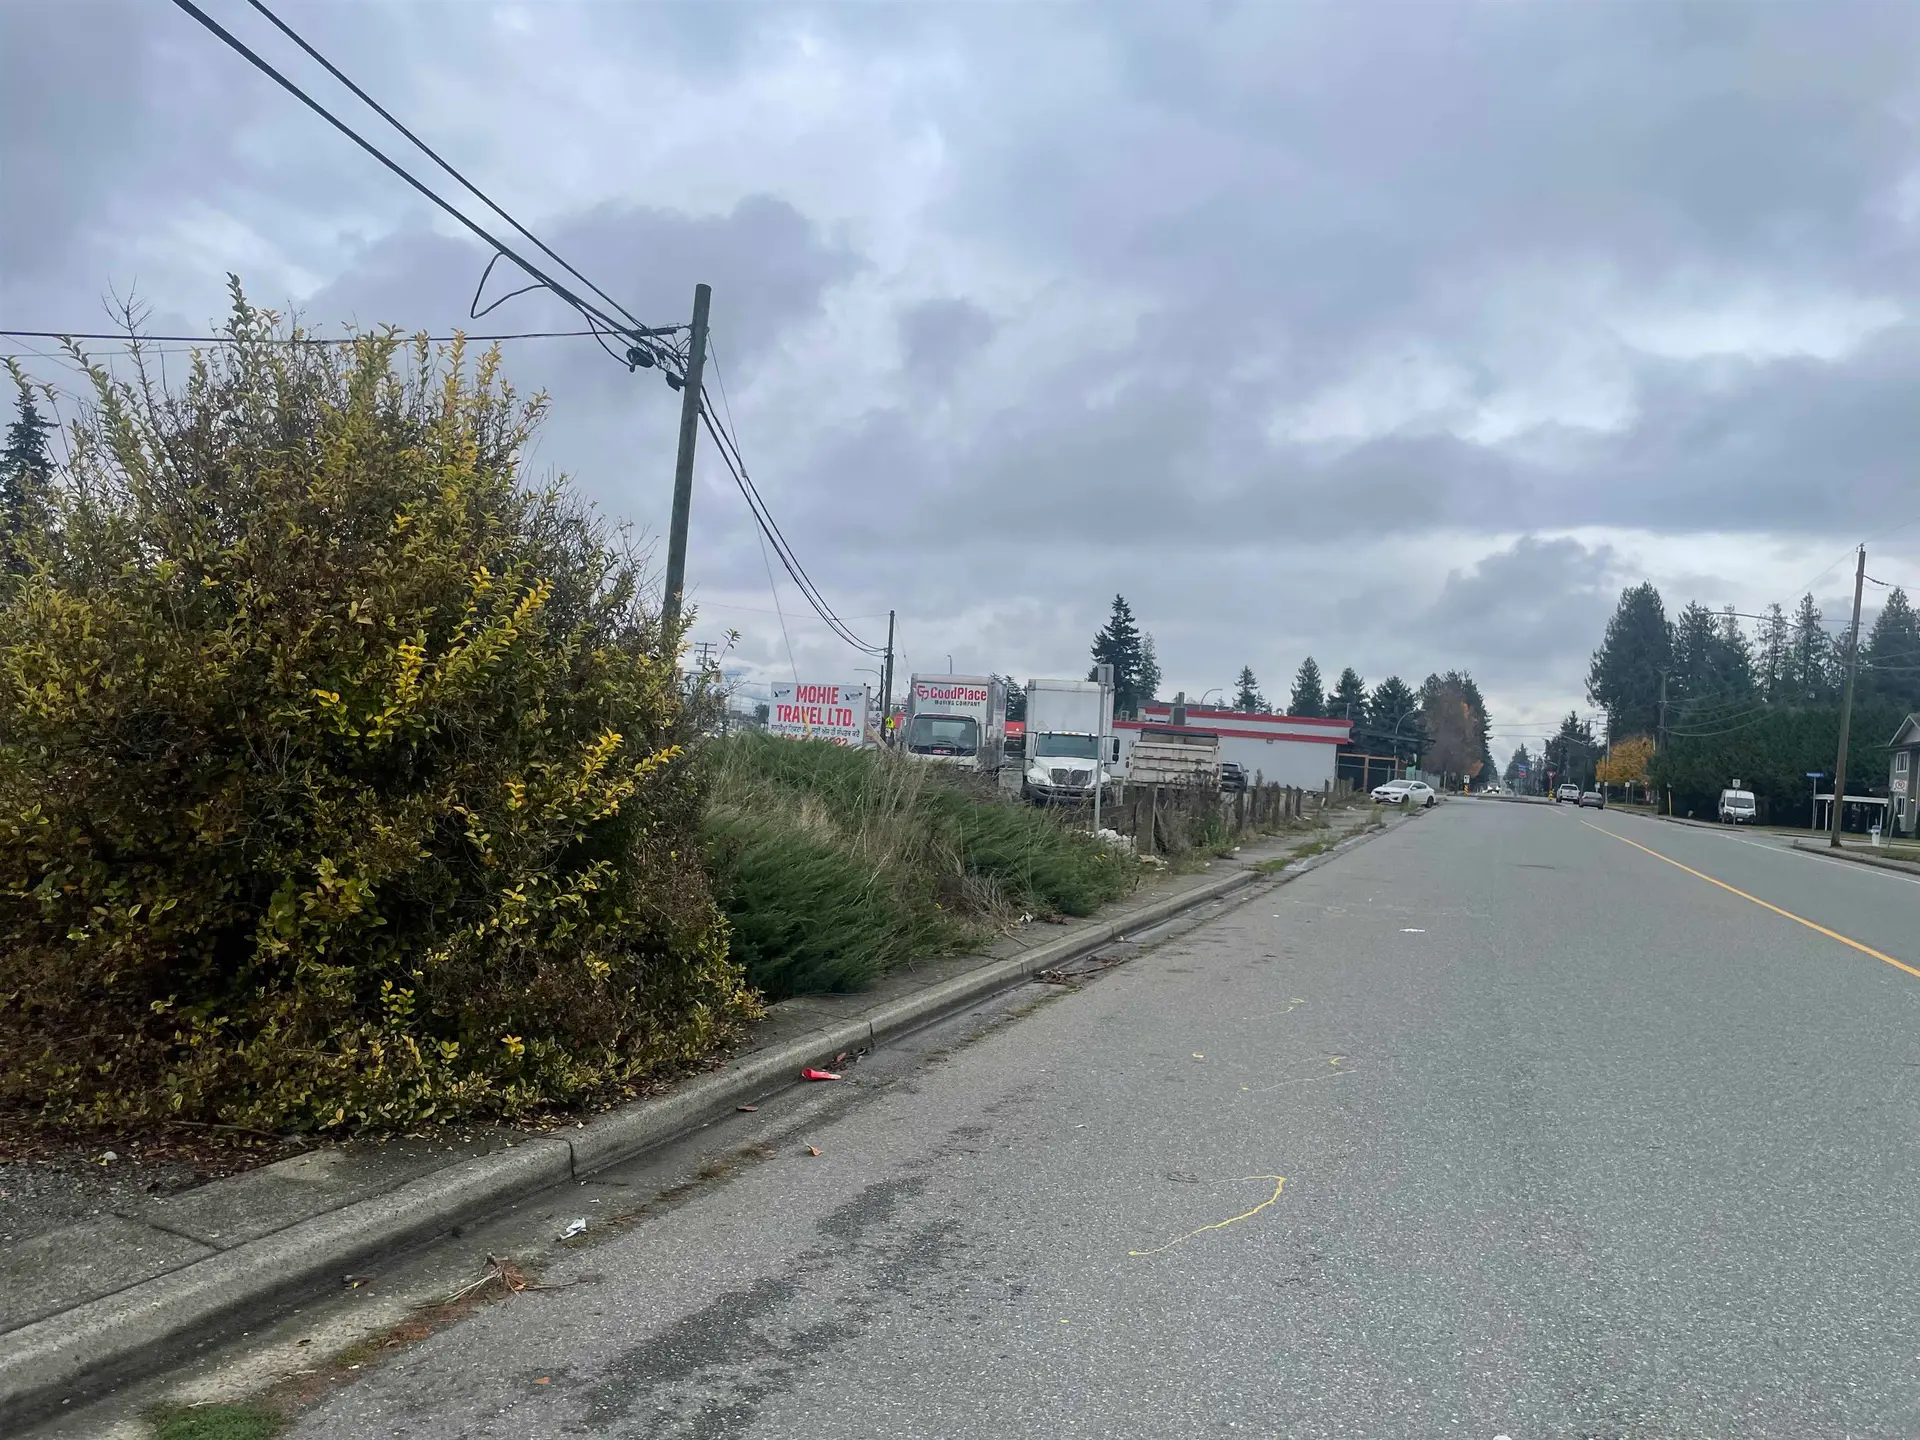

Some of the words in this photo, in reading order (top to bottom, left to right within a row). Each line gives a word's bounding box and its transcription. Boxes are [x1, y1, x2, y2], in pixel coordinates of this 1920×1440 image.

[796, 685, 839, 705] MOHIE
[930, 686, 987, 701] GoodPlace
[776, 704, 824, 725] TRAVEL
[827, 707, 856, 727] LTD.
